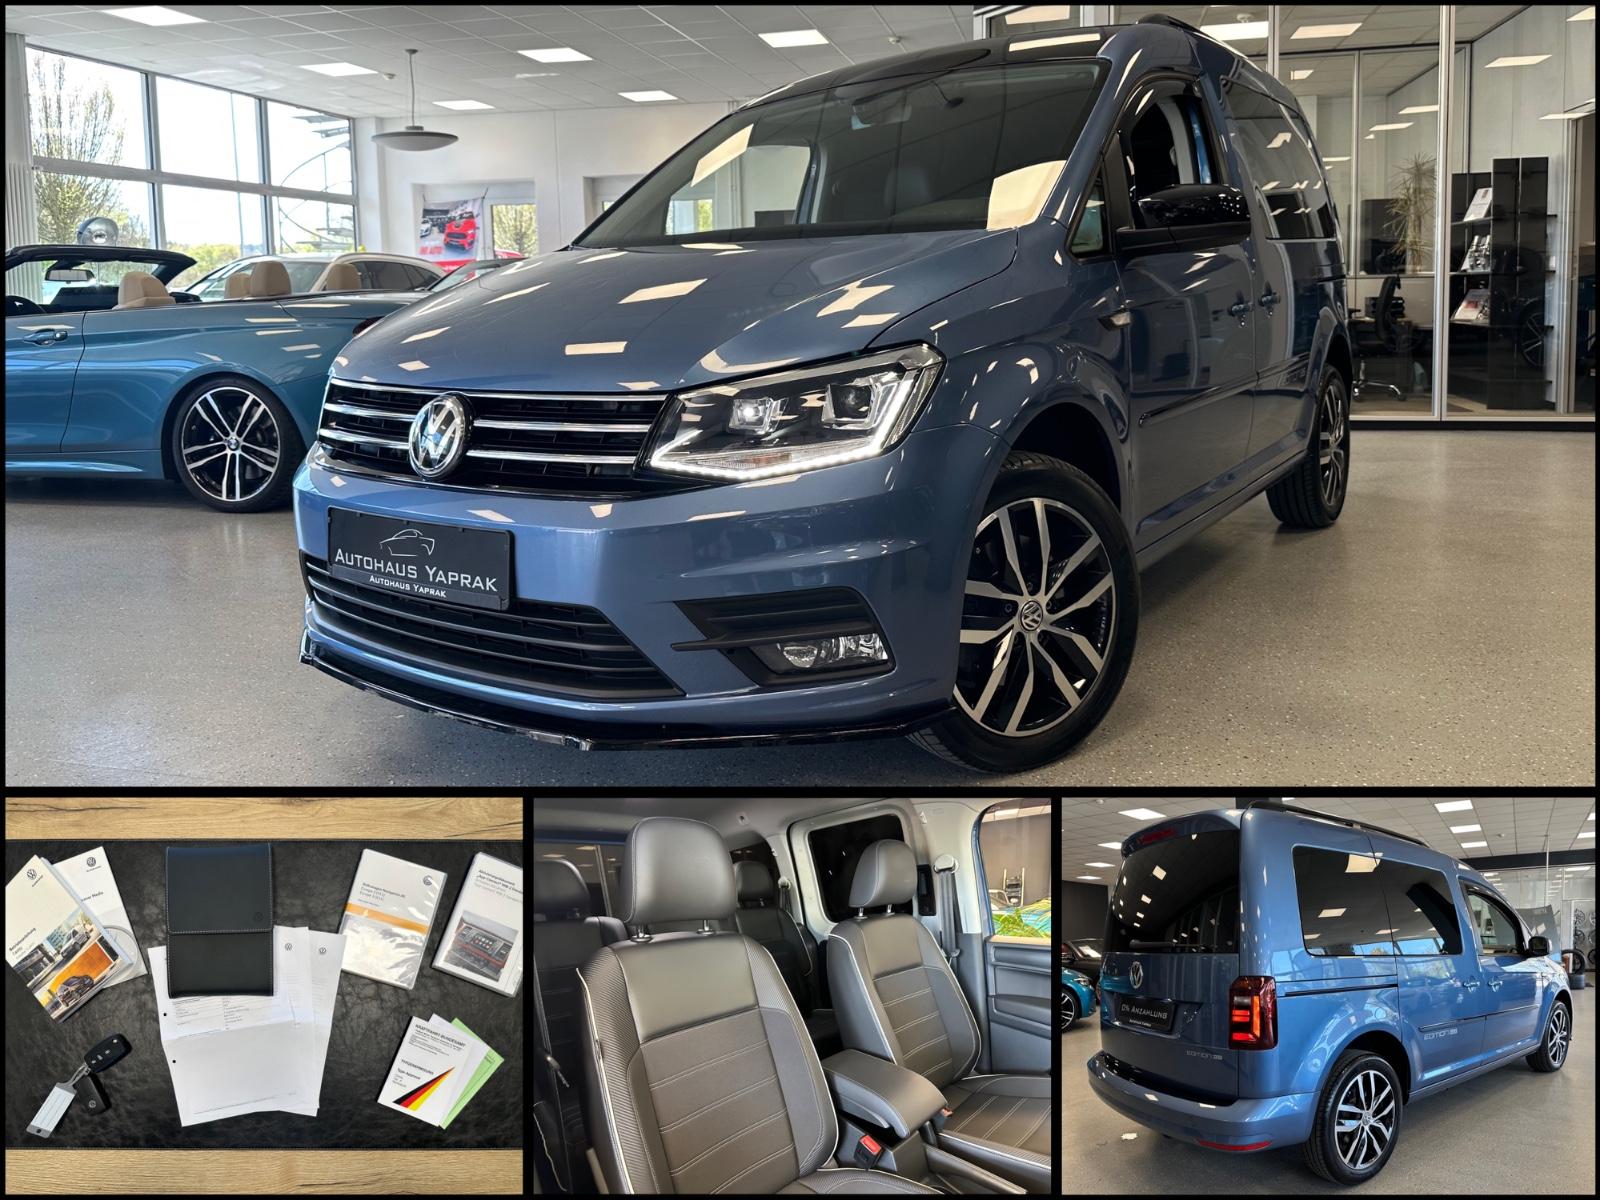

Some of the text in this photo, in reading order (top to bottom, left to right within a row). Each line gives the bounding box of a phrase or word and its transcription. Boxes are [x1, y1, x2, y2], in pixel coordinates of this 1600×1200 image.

[335, 548, 498, 592] AUTOHAUS YAPRAK
[369, 574, 447, 598] AUTOHAUS YAPRAK
